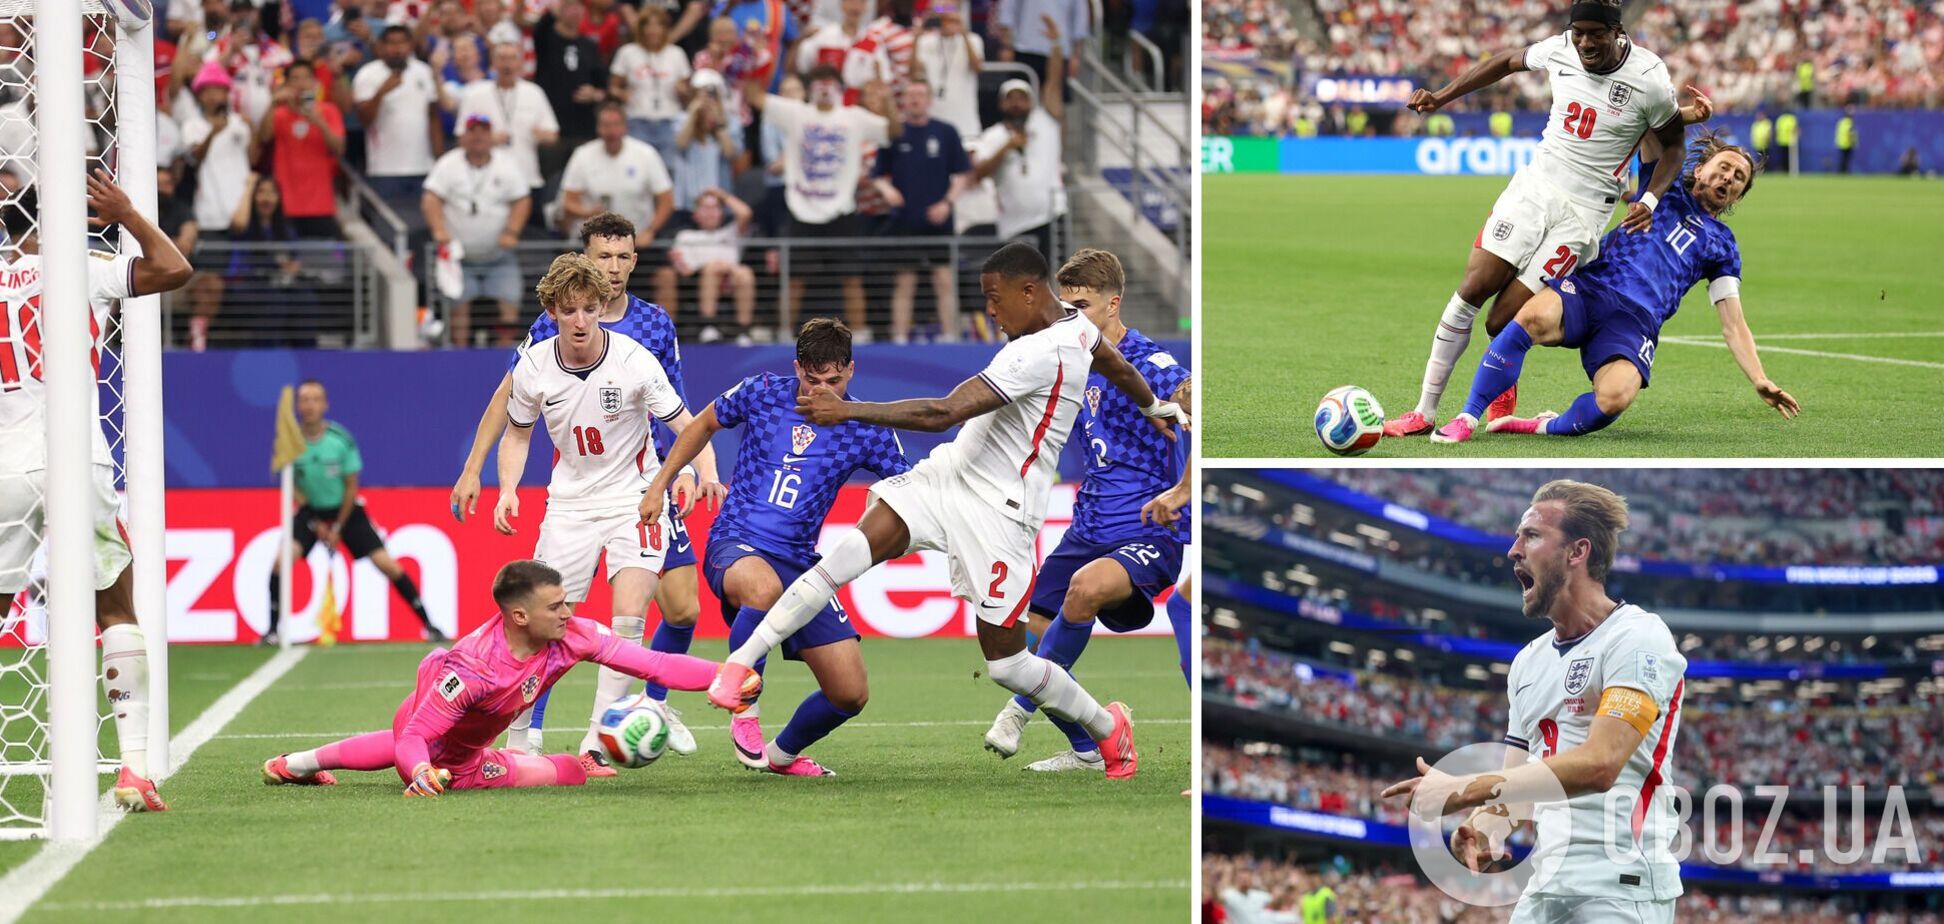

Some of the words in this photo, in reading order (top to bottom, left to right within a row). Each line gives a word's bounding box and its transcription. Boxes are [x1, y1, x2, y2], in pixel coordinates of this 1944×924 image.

[1563, 101, 1597, 139] 20
[1665, 221, 1697, 256] 10
[1543, 244, 1578, 279] 20
[573, 425, 605, 456] 18
[768, 469, 802, 509] 16
[635, 520, 662, 551] 18
[989, 561, 1009, 599] 2
[1538, 718, 1559, 757] 9
